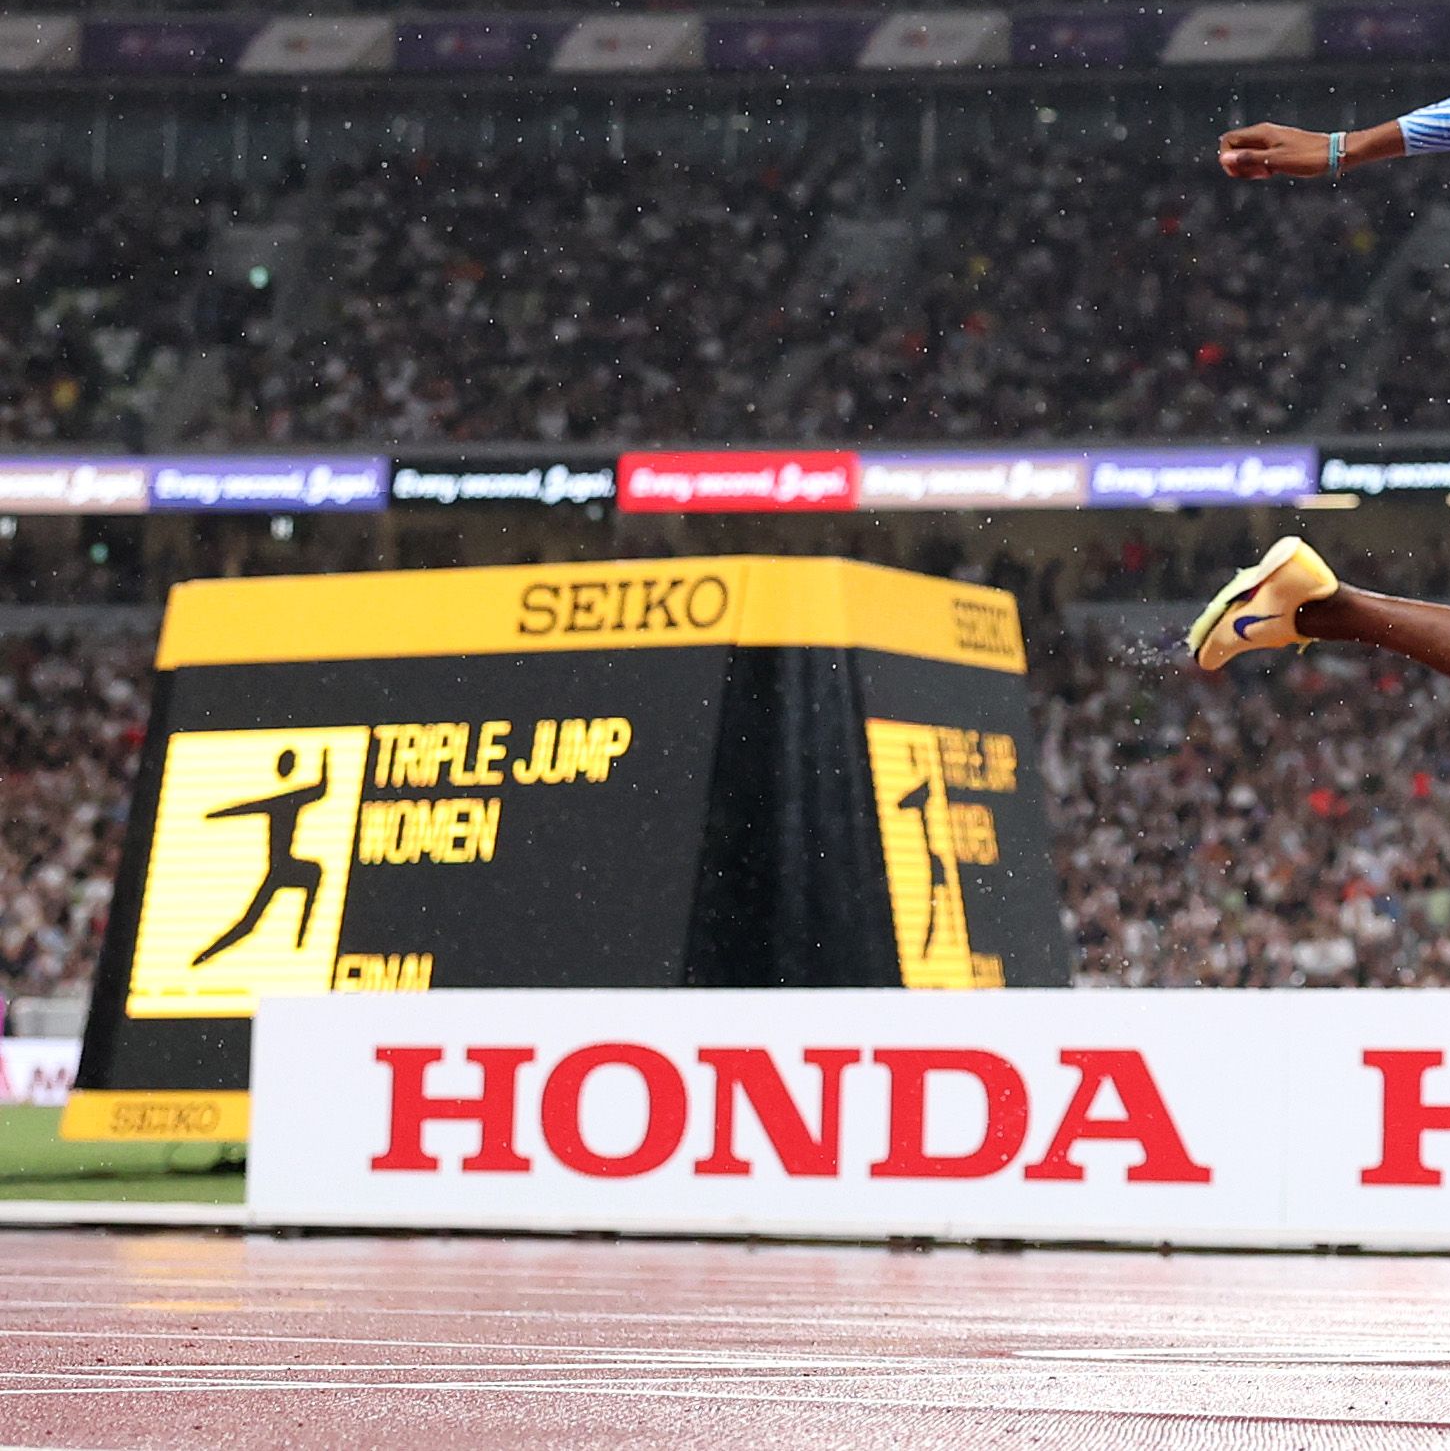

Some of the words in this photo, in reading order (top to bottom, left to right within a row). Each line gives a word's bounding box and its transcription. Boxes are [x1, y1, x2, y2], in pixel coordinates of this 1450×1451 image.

[517, 574, 728, 637] SEIKO
[373, 720, 512, 788] TRIPLE
[512, 717, 632, 785] JUMP
[358, 798, 502, 864] WOMEN
[111, 1100, 221, 1135] SEIKO
[370, 1041, 1213, 1183] HONDA
